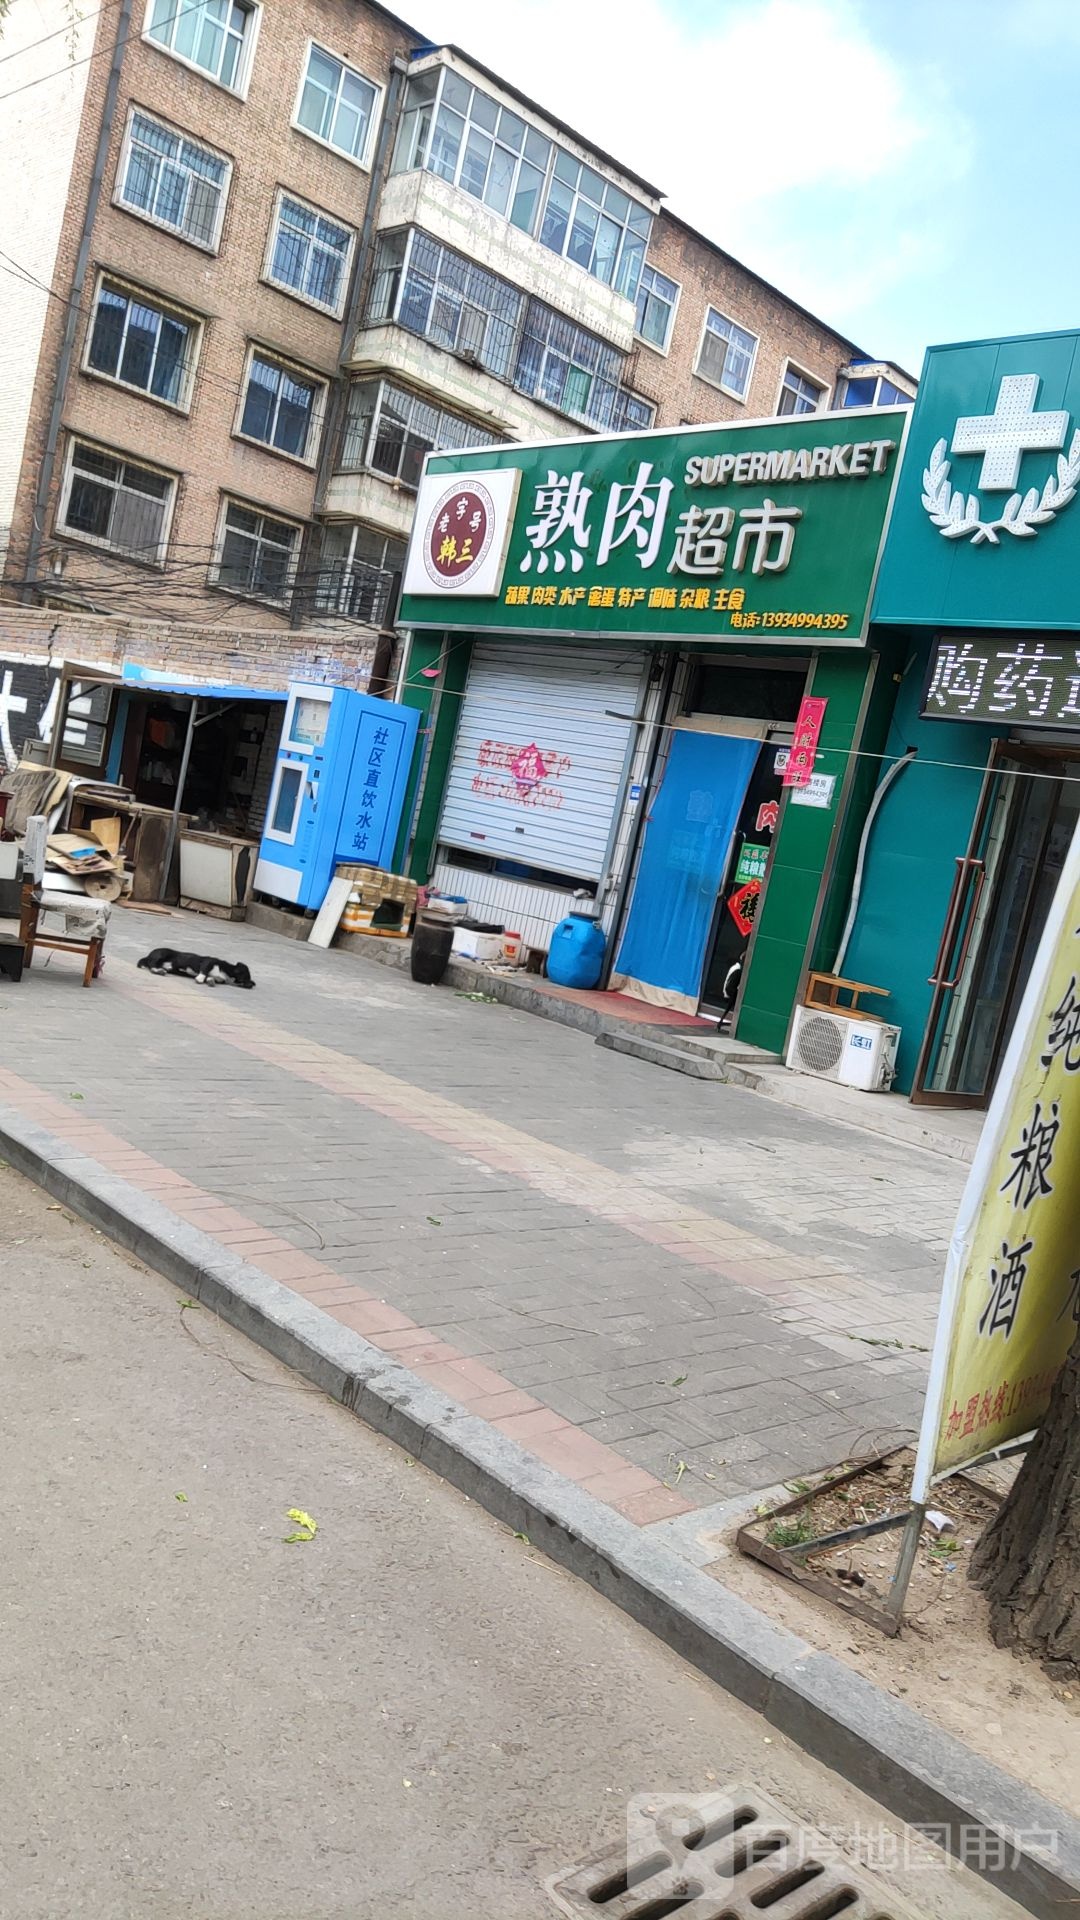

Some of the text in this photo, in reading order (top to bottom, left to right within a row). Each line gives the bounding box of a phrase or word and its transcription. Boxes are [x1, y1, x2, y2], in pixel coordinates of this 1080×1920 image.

[684, 440, 895, 486] SUPERMARKET
[438, 497, 482, 533] 老字号
[519, 461, 803, 576] 熟肉 超市
[436, 534, 474, 568] 韩三
[531, 586, 557, 606] 肉类
[559, 586, 586, 607] 水产
[618, 587, 646, 608] 特产
[679, 587, 711, 609] 杂粮
[712, 587, 745, 611] 主食
[927, 643, 1080, 718] 购药
[352, 727, 390, 851] 社区直饮水站
